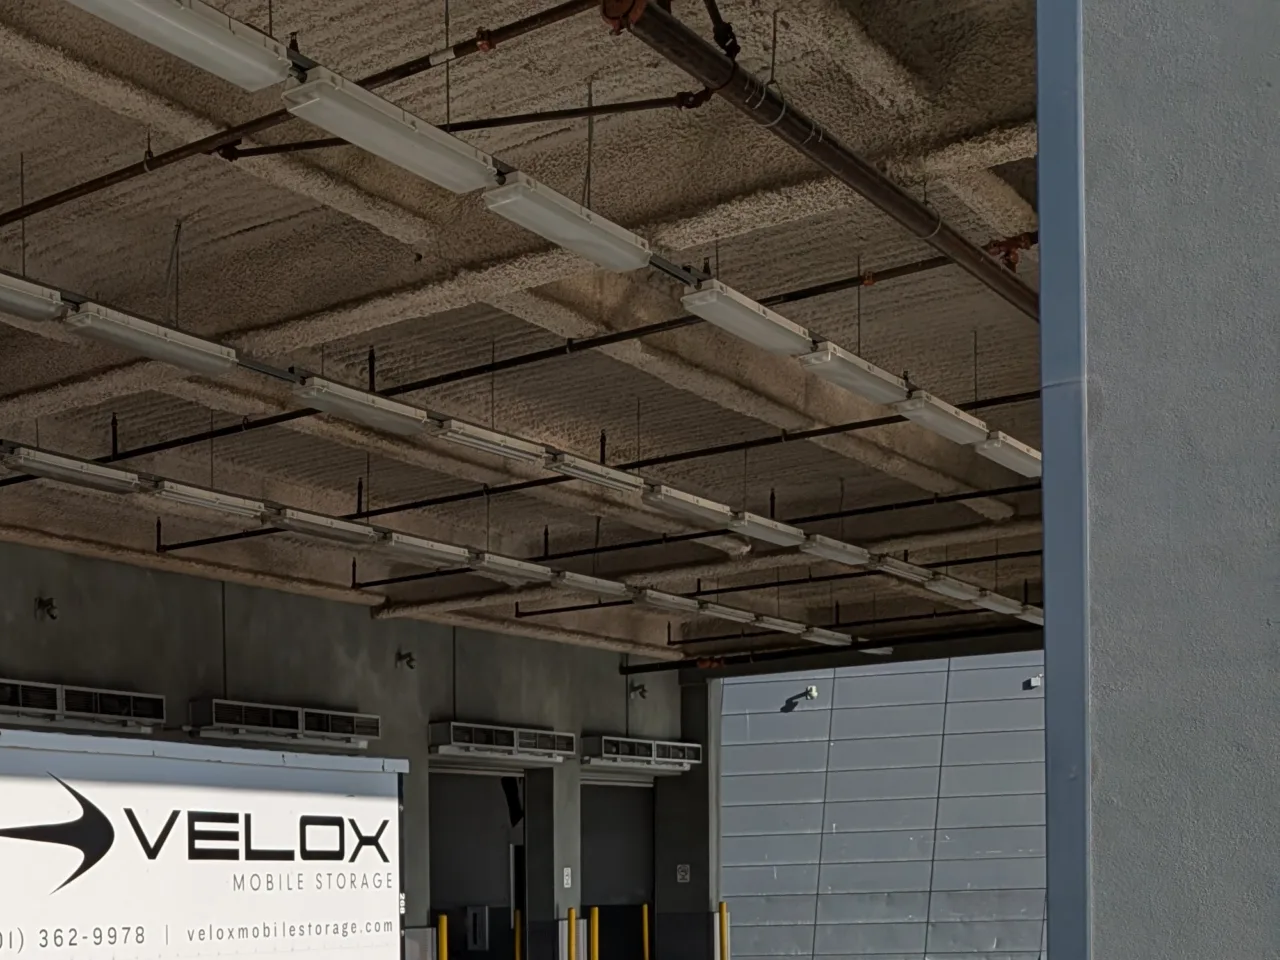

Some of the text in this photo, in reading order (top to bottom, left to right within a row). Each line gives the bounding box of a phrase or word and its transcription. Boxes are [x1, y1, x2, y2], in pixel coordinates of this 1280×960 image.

[122, 807, 390, 863] VELOX
[232, 872, 393, 892] MOBILE STORAGE
[39, 925, 146, 949] 362-9978
[187, 920, 394, 942] veloxmobilestorage.com
